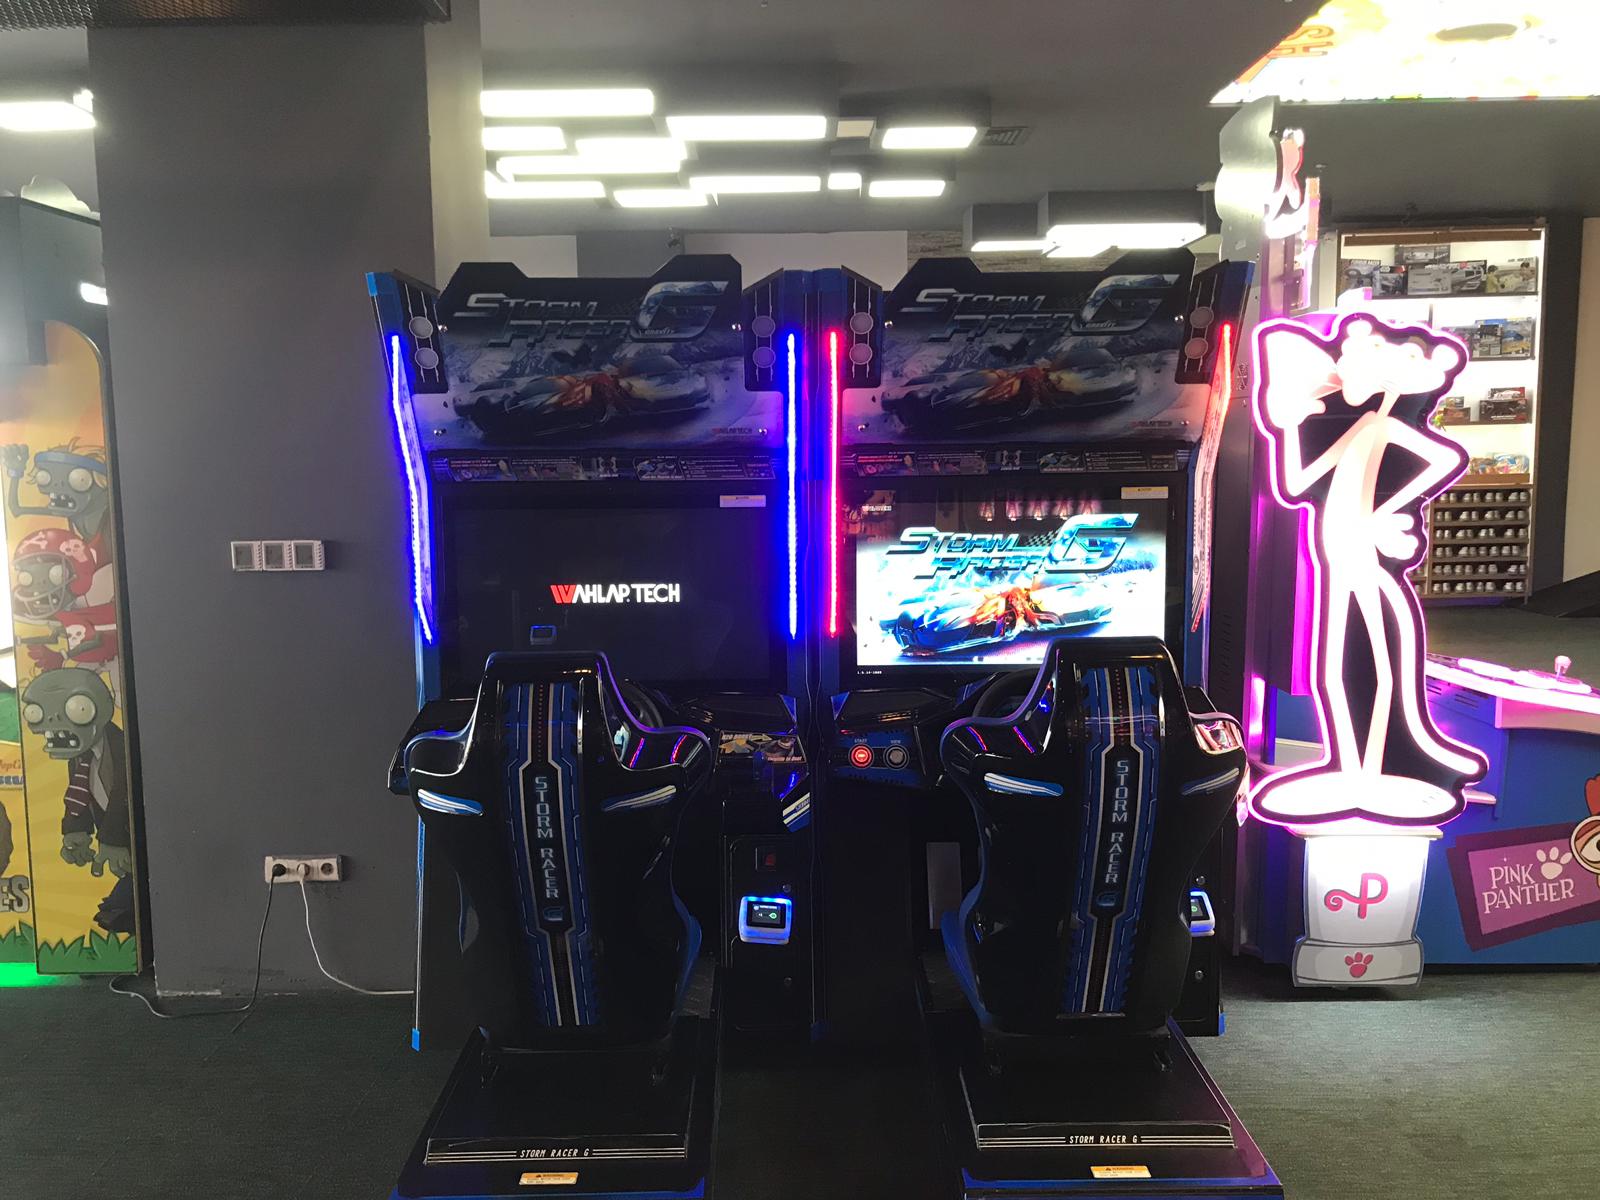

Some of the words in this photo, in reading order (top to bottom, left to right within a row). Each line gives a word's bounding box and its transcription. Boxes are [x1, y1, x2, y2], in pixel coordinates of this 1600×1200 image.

[453, 292, 597, 318] STORM
[899, 287, 1046, 313] STORM
[487, 319, 631, 347] RACER
[928, 313, 1074, 342] RACER
[886, 527, 1019, 556] STORM
[1111, 760, 1129, 823] STORM
[535, 776, 553, 839] STORM
[1105, 832, 1124, 884] RACER
[540, 847, 560, 899] RACER
[1489, 859, 1536, 890] PINK
[1482, 878, 1576, 914] PANTHER
[519, 1149, 547, 1158] STORM
[550, 1148, 579, 1158] RACER
[583, 1148, 590, 1157] G
[1069, 1135, 1095, 1144] STORM
[1099, 1135, 1127, 1144] RACER
[1132, 1135, 1138, 1143] G
